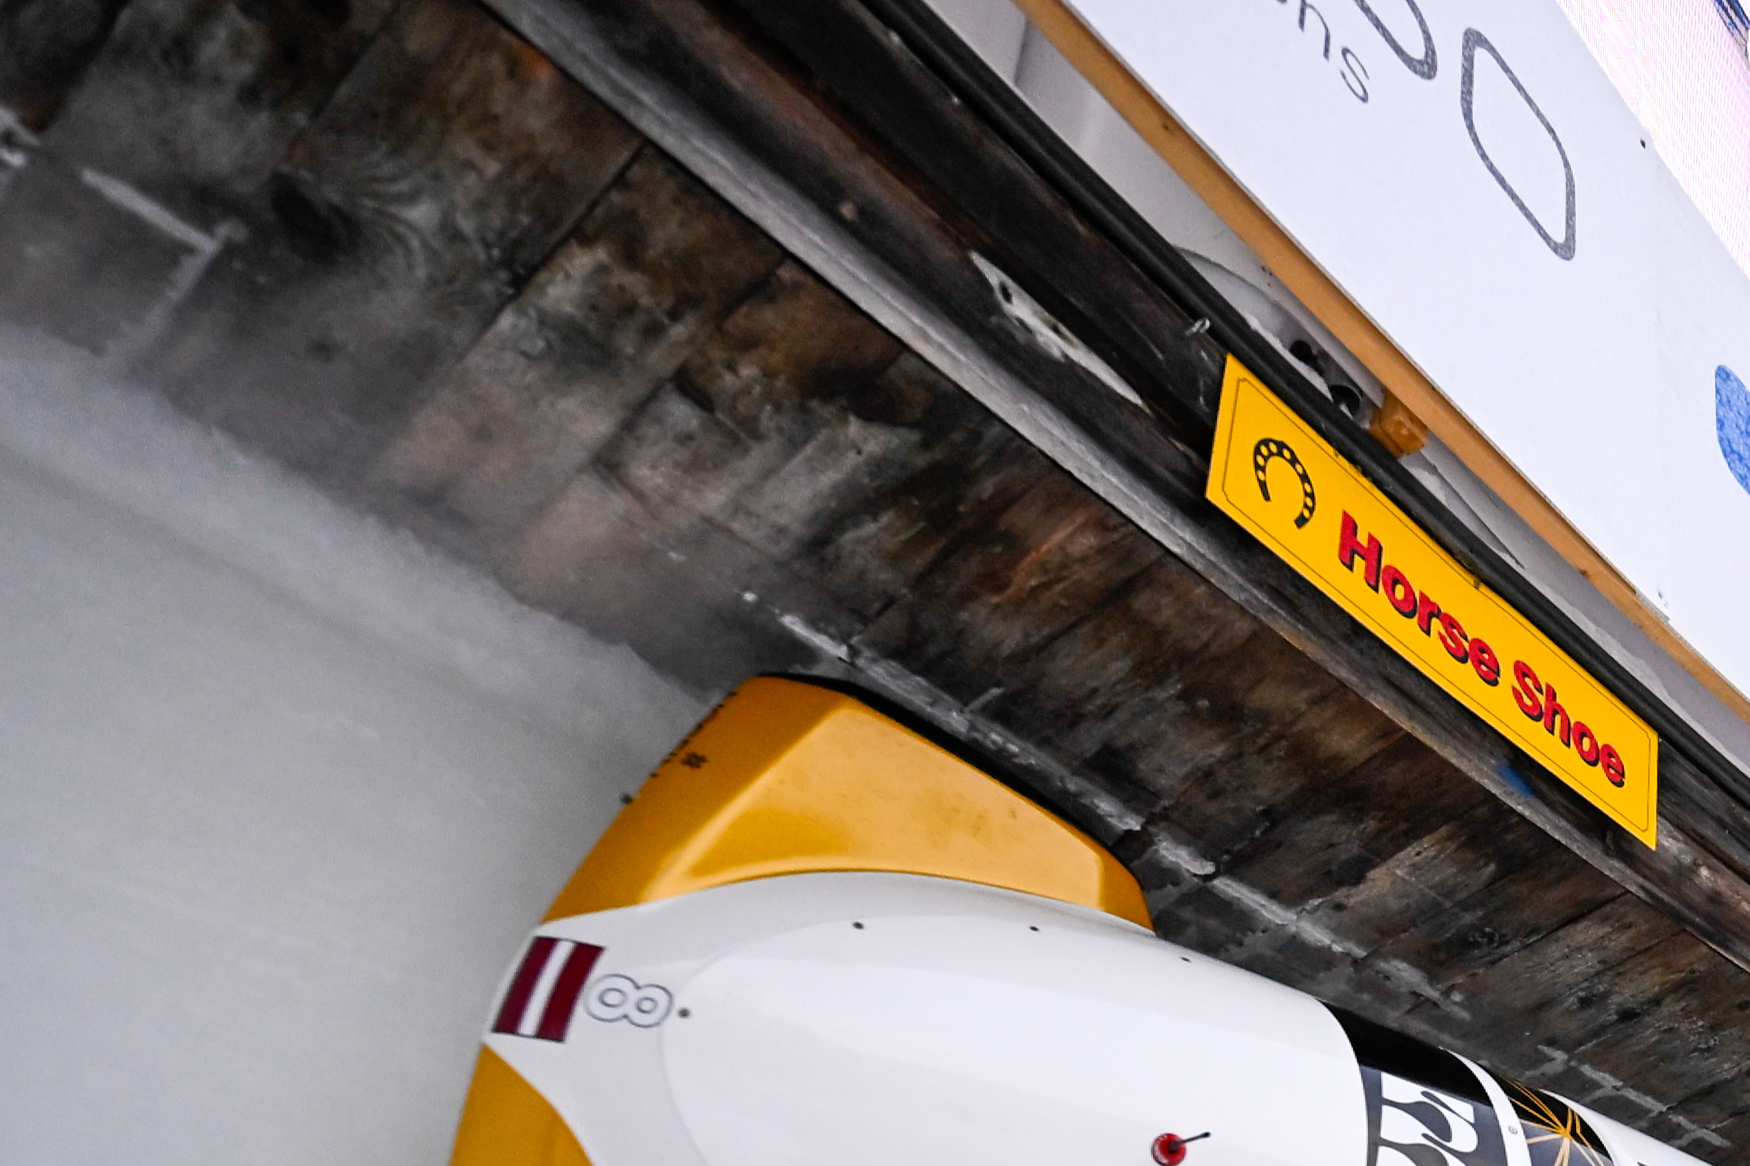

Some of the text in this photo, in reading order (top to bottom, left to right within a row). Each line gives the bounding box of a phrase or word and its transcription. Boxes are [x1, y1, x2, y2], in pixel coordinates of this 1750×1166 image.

[1276, 0, 1369, 103] ns
[1337, 510, 1626, 788] Horse Shoe
